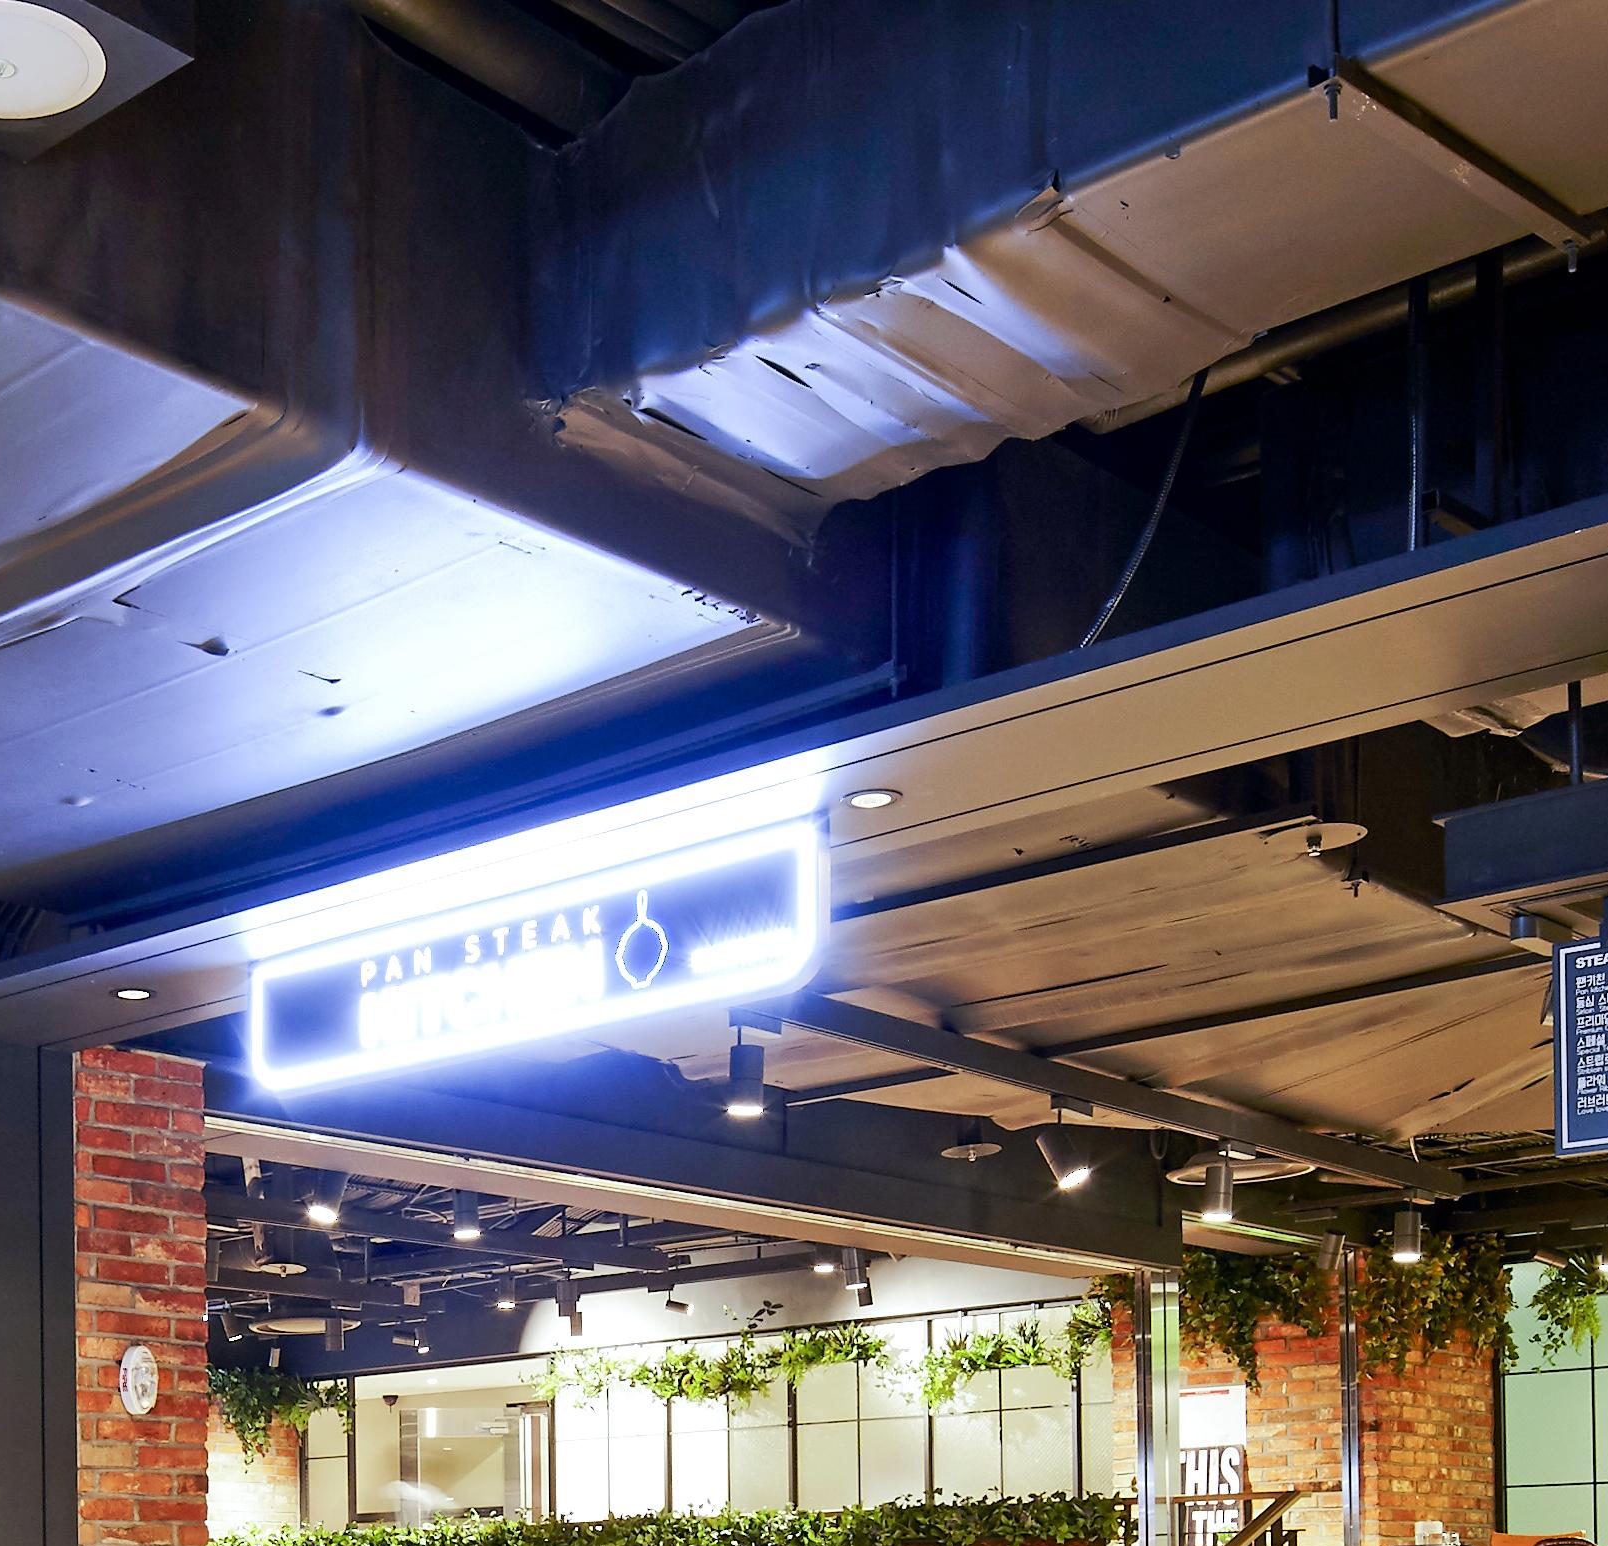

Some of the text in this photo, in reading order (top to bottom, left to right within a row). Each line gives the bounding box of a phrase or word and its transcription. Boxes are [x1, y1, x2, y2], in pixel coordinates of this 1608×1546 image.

[360, 904, 604, 988] PAN STEAK
[1575, 972, 1605, 989] 팬키친
